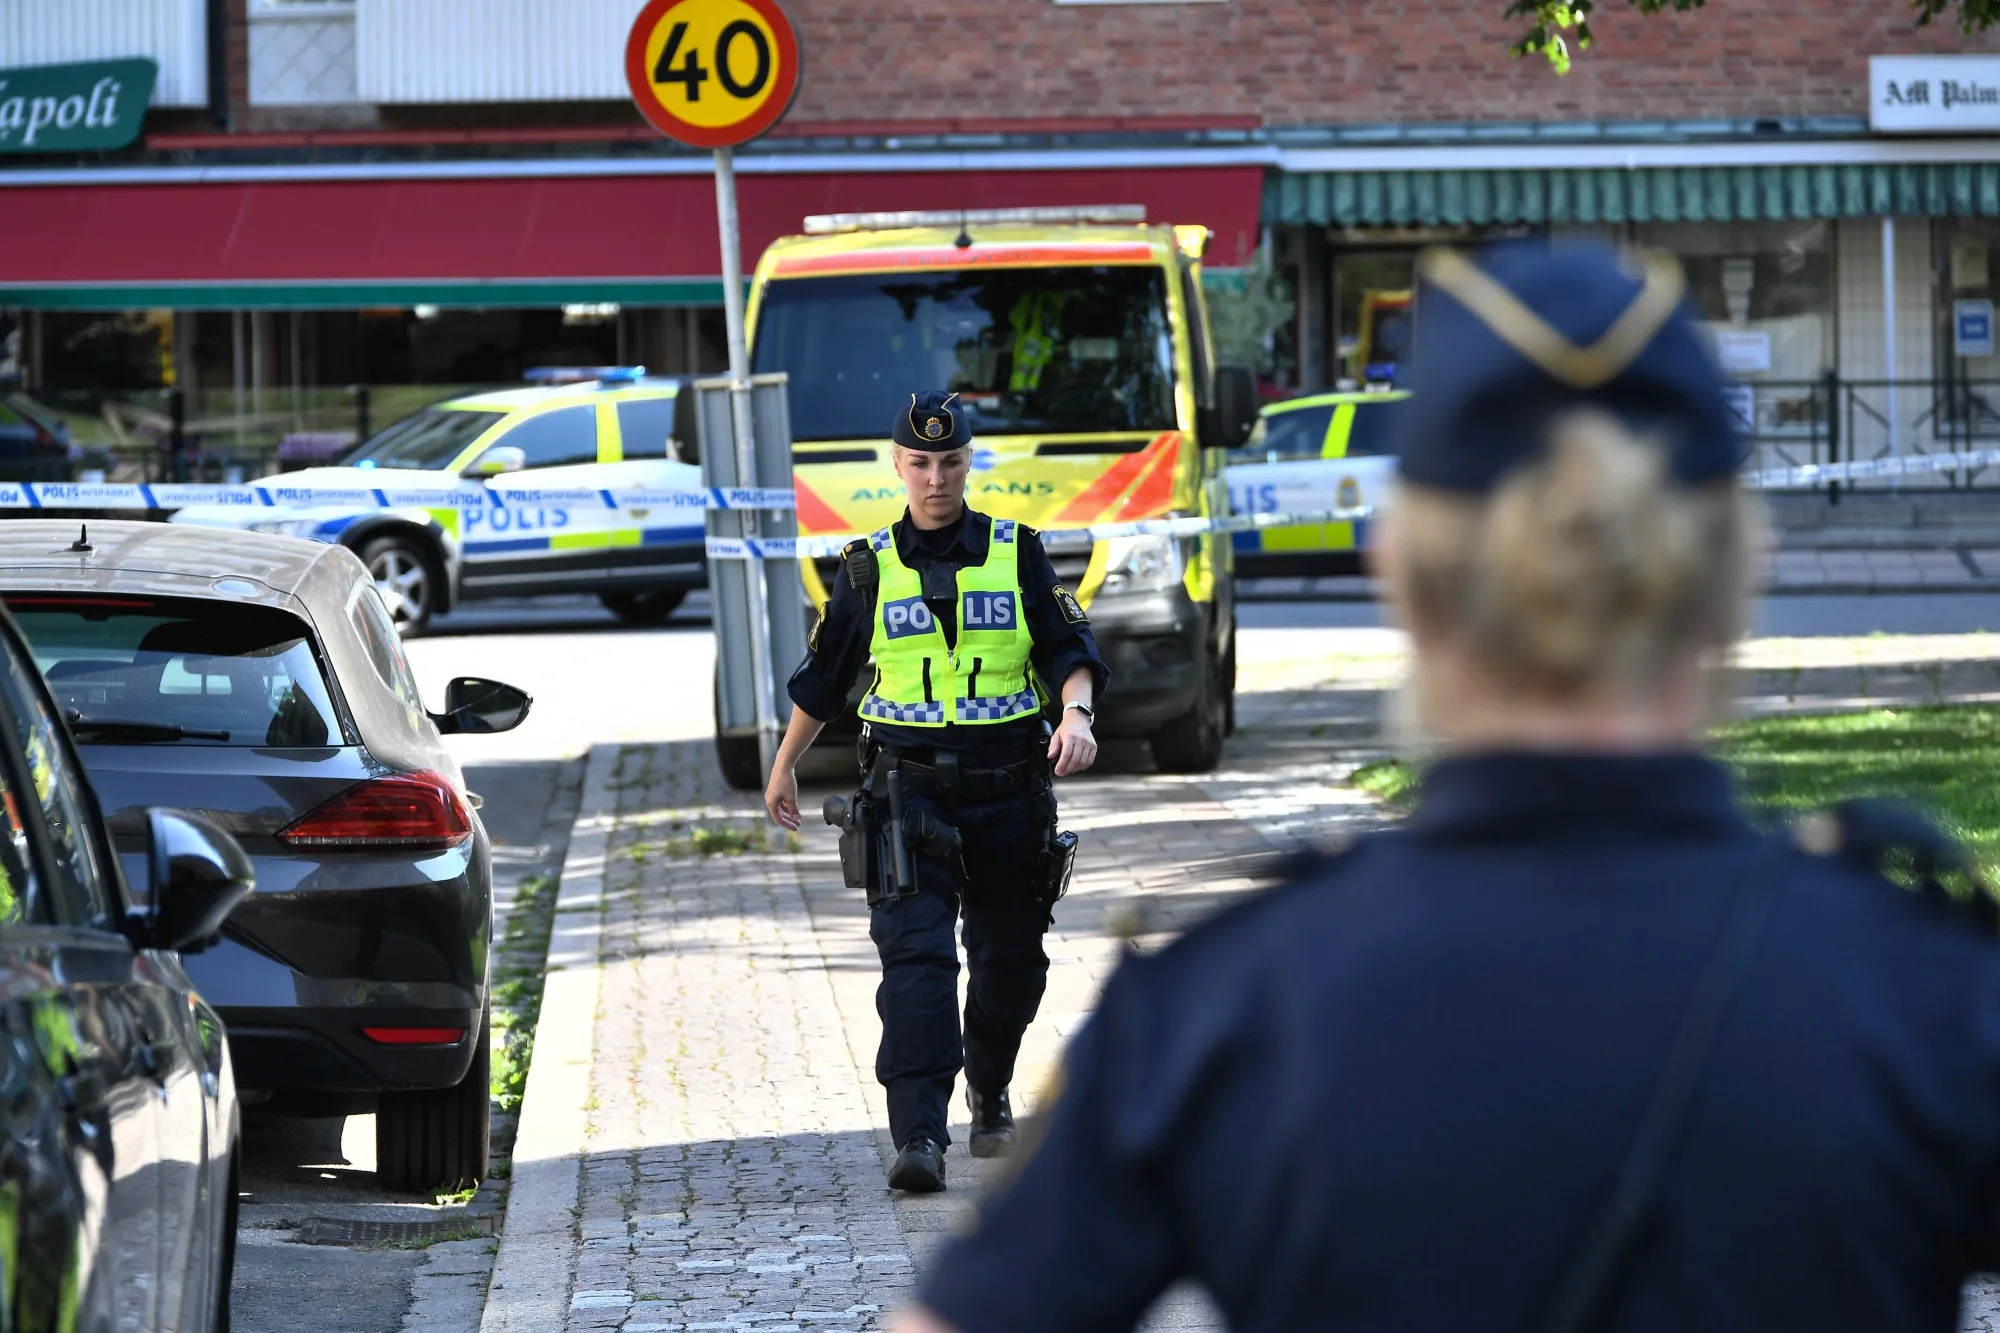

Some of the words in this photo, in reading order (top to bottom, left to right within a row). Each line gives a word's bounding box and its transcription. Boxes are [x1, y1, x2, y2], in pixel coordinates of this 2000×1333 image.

[653, 18, 771, 103] 40
[1940, 78, 2000, 112] Palm
[0, 76, 122, 147] apoli
[42, 485, 79, 499] POLIS
[216, 491, 253, 504] POLIS
[275, 488, 312, 501] POLIS
[448, 492, 483, 505] POLIS
[506, 489, 542, 502] POLIS
[730, 490, 765, 503] POLIS
[1228, 483, 1279, 514] LIS
[463, 507, 569, 533] POLIS
[887, 601, 931, 633] PO
[966, 596, 1011, 625] LIS
